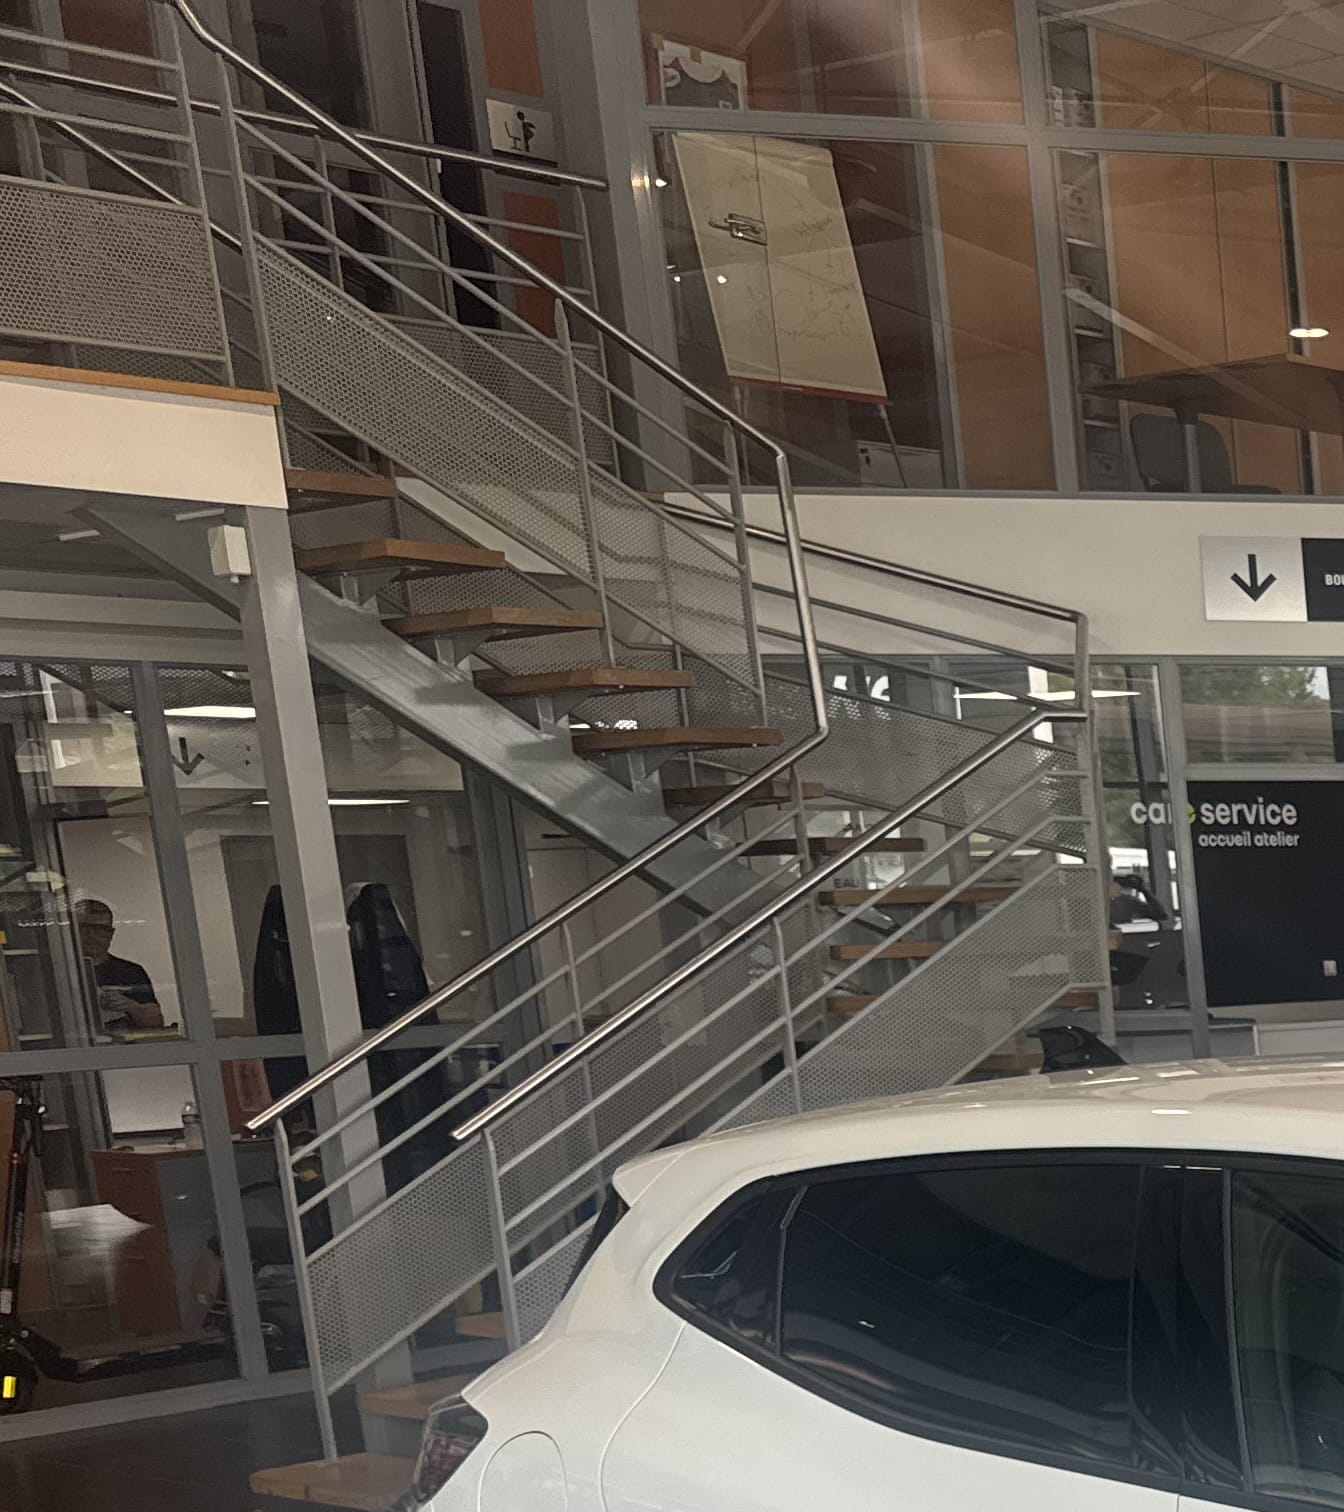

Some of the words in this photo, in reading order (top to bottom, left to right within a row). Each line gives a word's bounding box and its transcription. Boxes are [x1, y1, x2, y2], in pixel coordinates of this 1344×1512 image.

[1200, 797, 1297, 825] service
[1198, 831, 1251, 847] accueil
[1254, 831, 1300, 847] atelier
